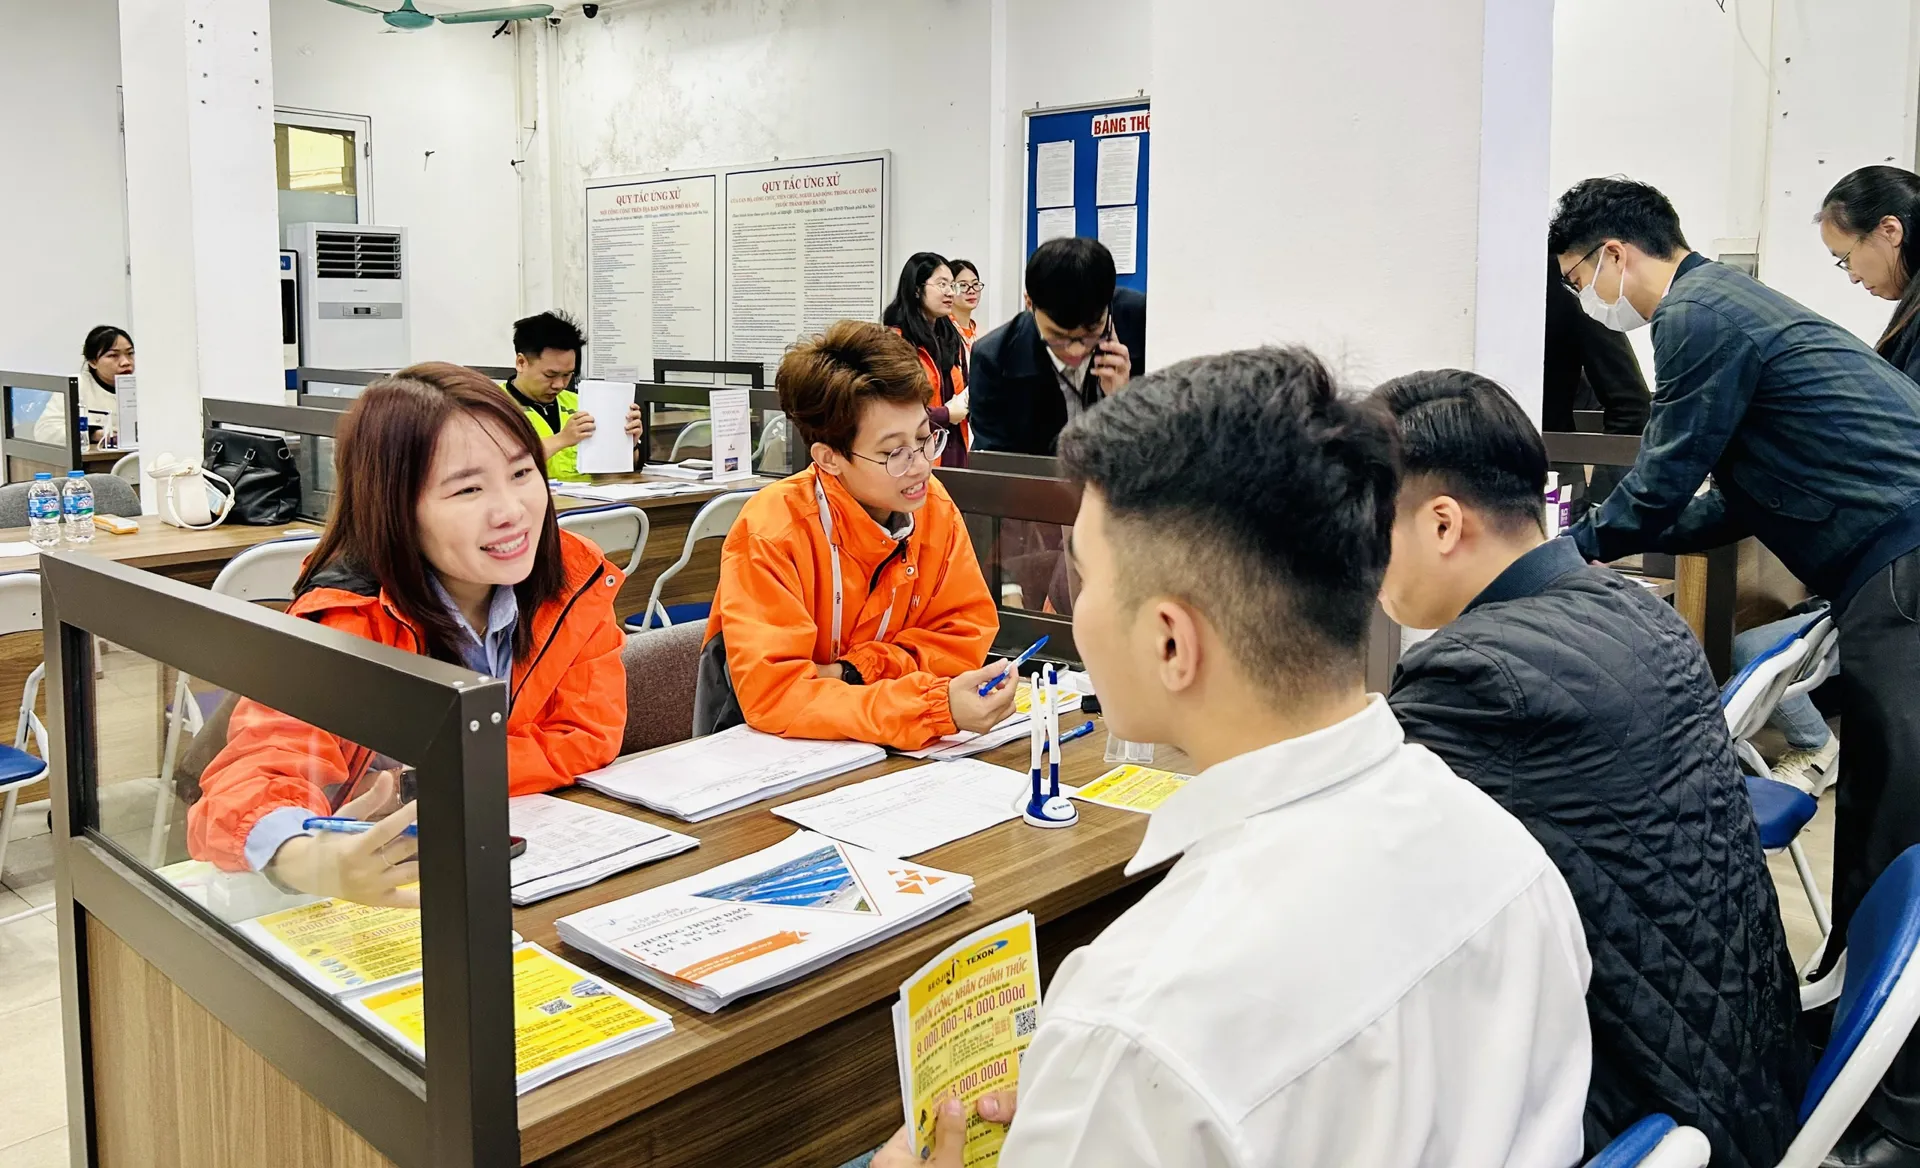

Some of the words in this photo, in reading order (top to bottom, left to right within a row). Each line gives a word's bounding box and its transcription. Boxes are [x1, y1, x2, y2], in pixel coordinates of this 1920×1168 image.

[1094, 114, 1126, 135] BẢNG
[762, 180, 781, 194] QUY
[783, 174, 801, 190] TẮC
[803, 174, 824, 189] ỨNG
[826, 171, 842, 187] XỬ
[616, 194, 632, 206] QUY
[633, 189, 649, 203] TẮC
[650, 189, 668, 202] ỨNG
[669, 186, 682, 200] XỬ
[966, 948, 994, 966] TEXON
[933, 993, 954, 1016] CÔNG
[954, 979, 977, 1002] NHÂN
[977, 967, 1004, 989] CHÍNH
